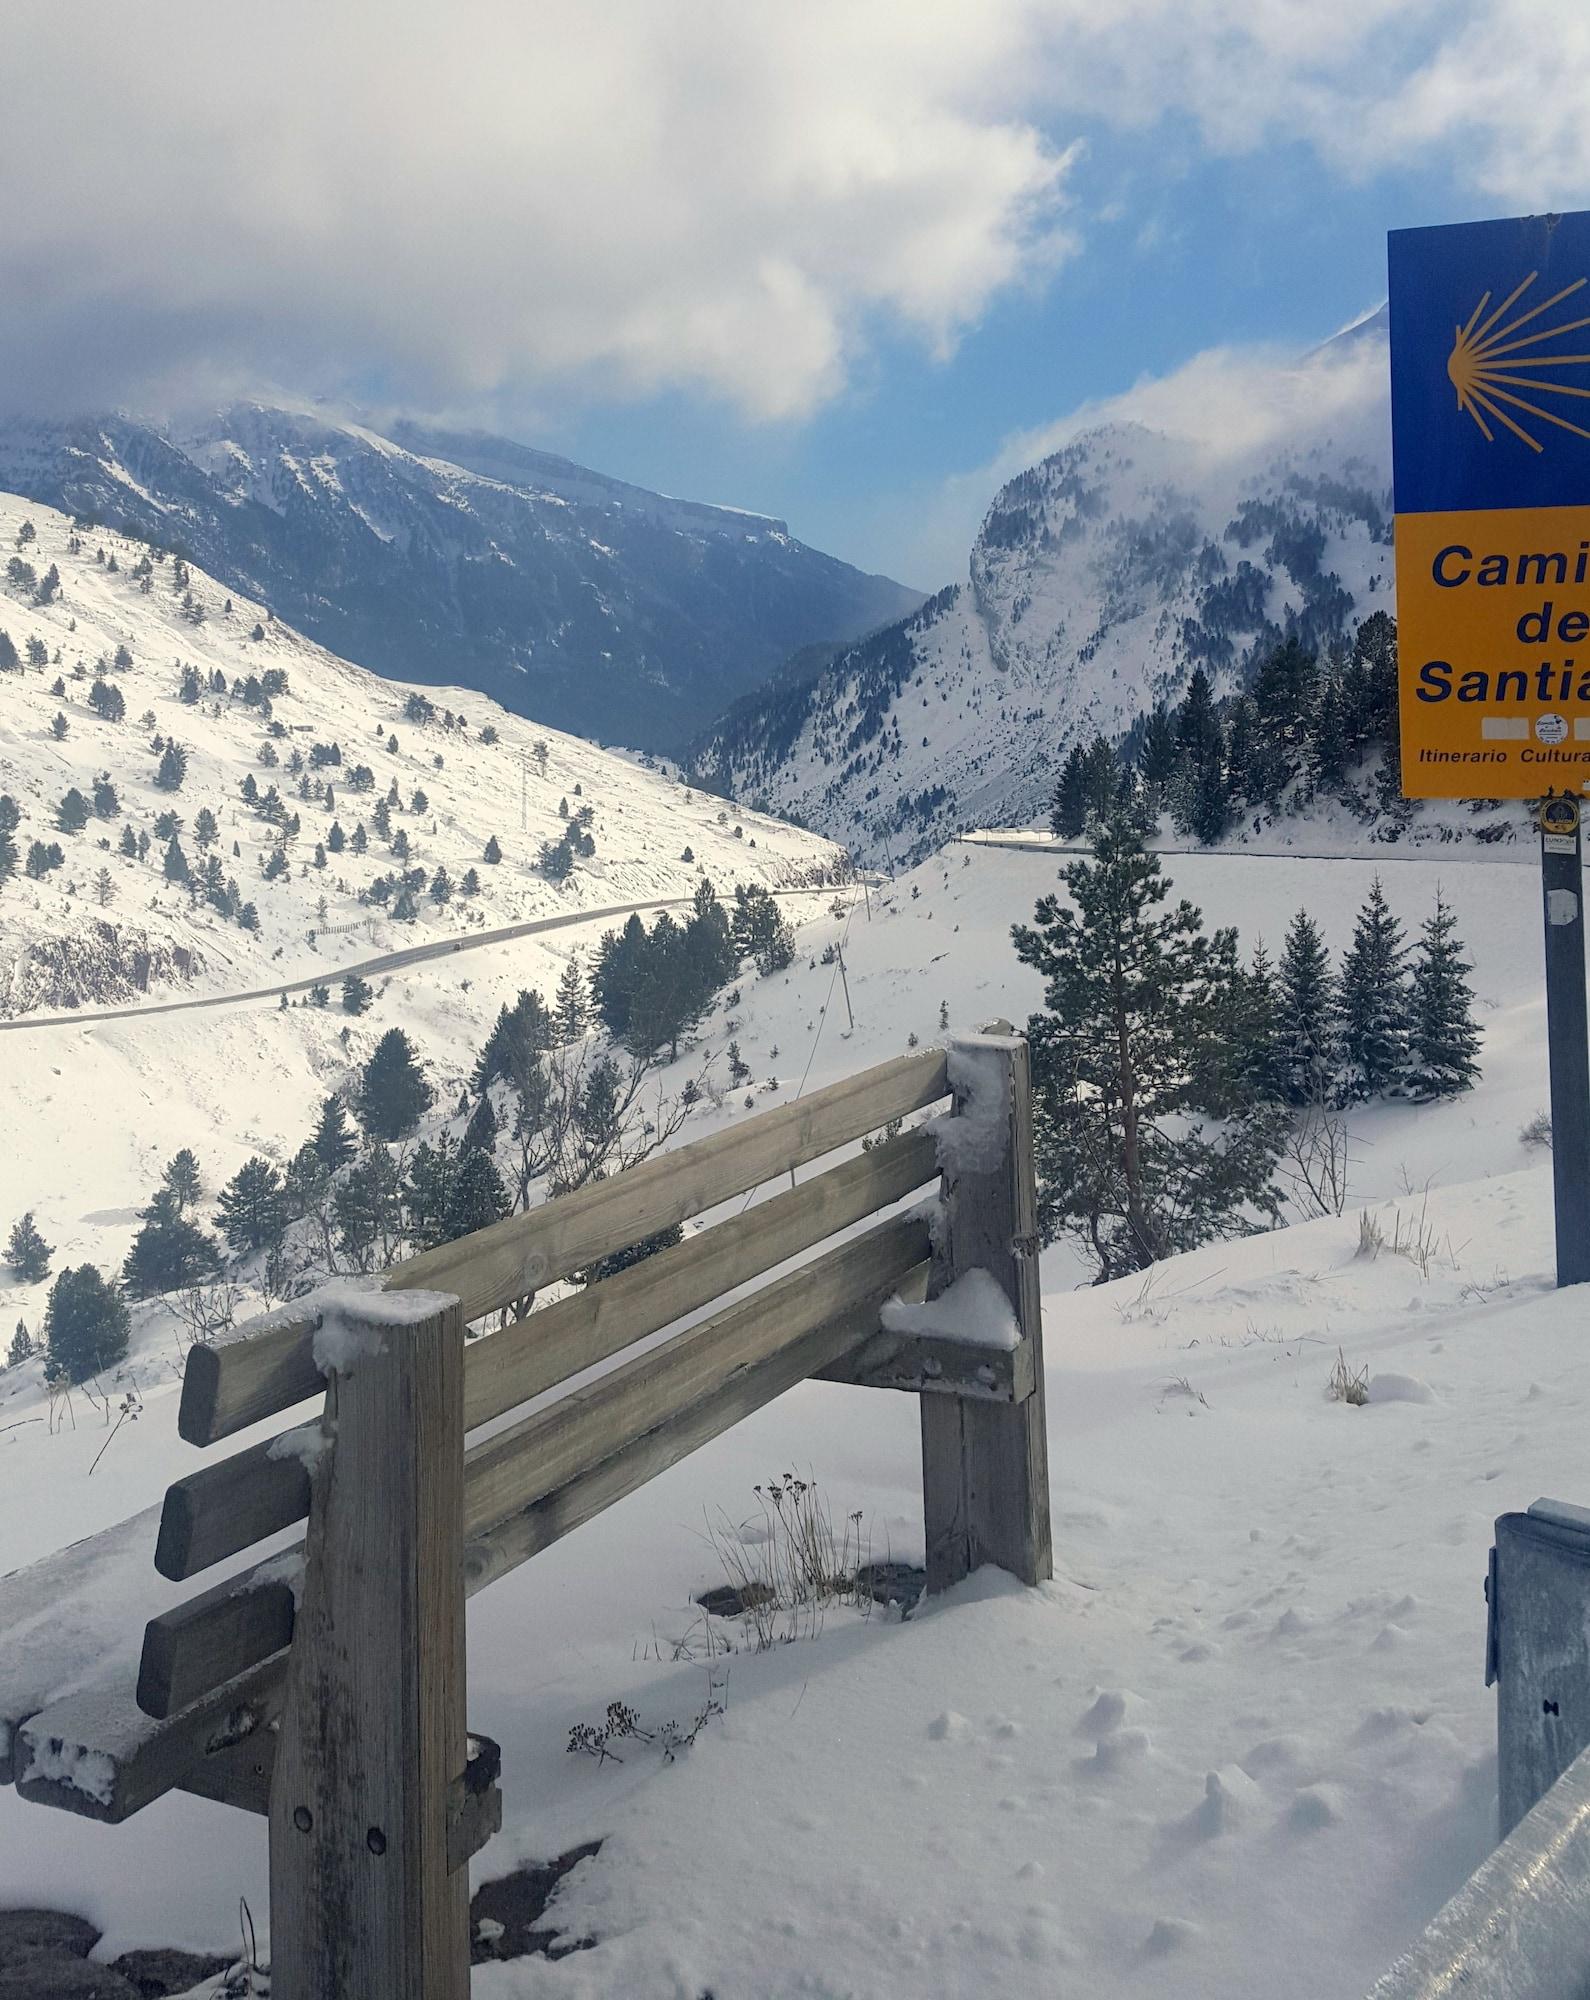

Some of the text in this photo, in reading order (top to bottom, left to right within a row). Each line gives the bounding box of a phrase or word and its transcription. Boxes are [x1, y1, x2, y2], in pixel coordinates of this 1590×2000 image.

[1432, 541, 1590, 588] Cami
[1516, 601, 1590, 644] de
[1419, 748, 1590, 763] Itinerario Cultura
